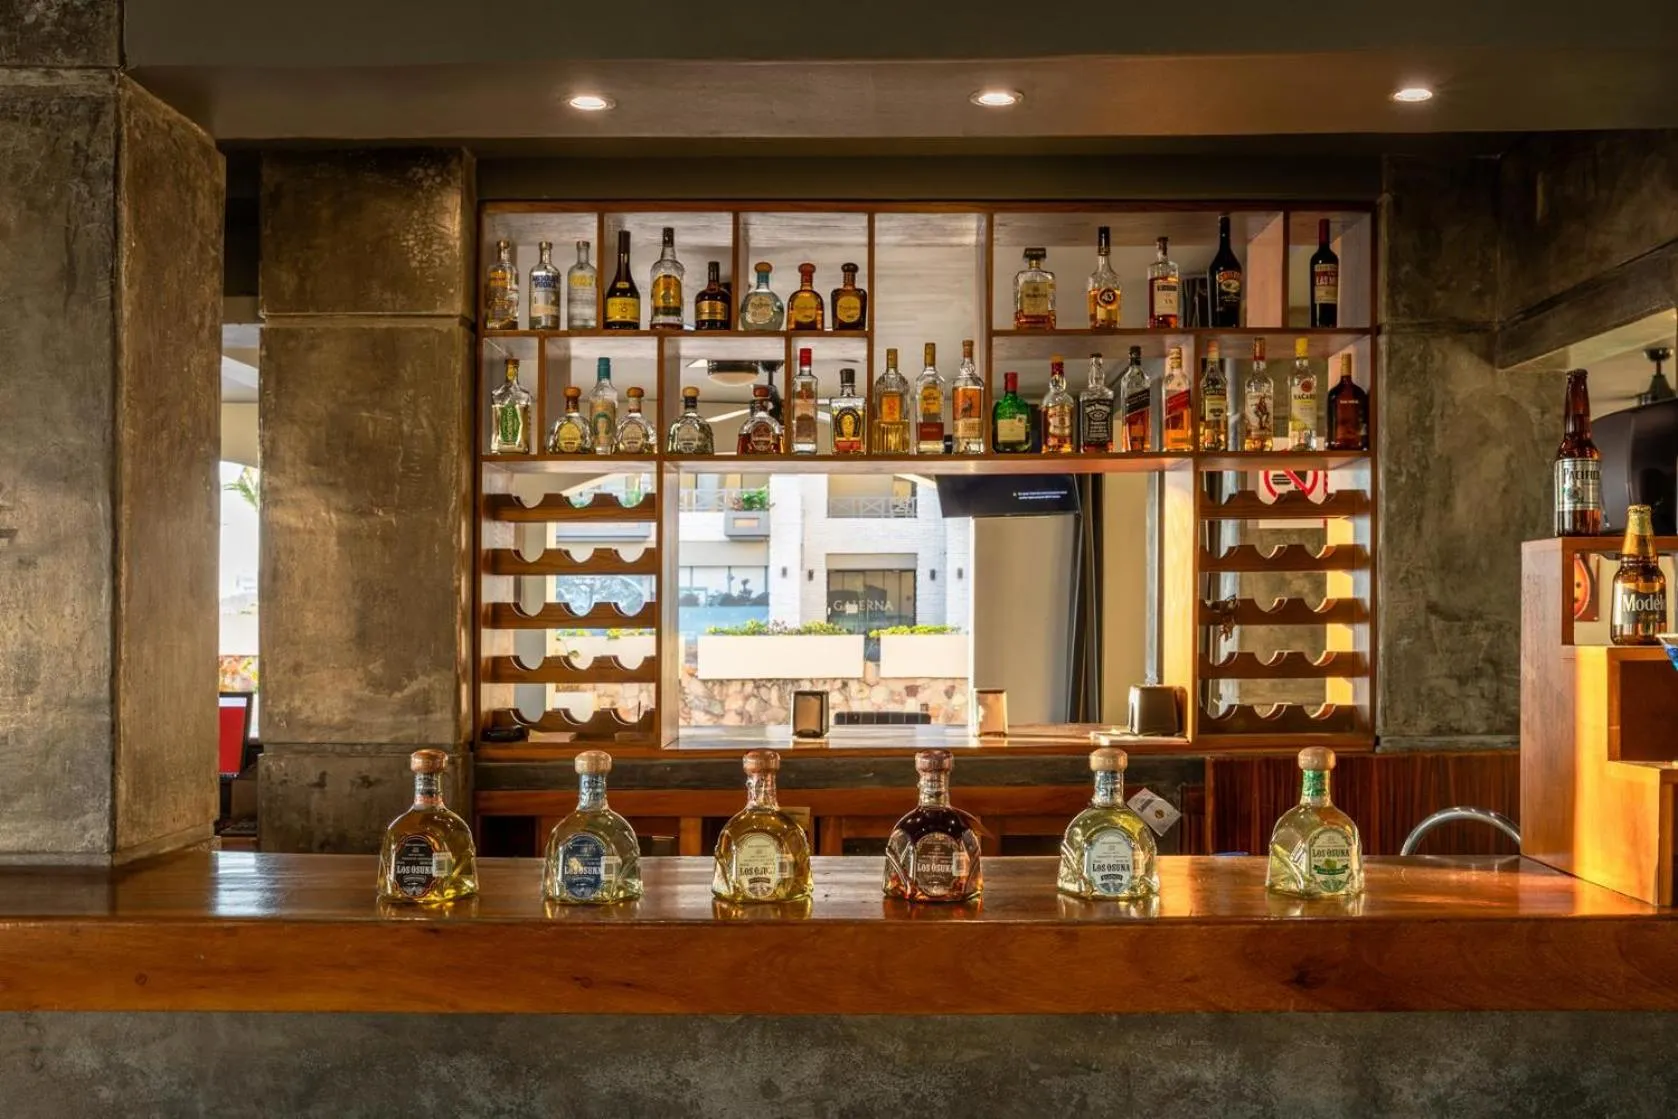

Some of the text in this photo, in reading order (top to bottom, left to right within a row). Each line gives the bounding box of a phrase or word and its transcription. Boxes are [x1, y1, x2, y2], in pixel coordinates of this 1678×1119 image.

[1101, 292, 1114, 302] 43
[1622, 594, 1665, 612] Model
[1312, 848, 1350, 857] LOS OSUNA
[396, 865, 410, 874] LOS
[739, 866, 753, 876] LOS
[917, 863, 930, 872] LOS
[1092, 863, 1130, 872] LOS OSUNA
